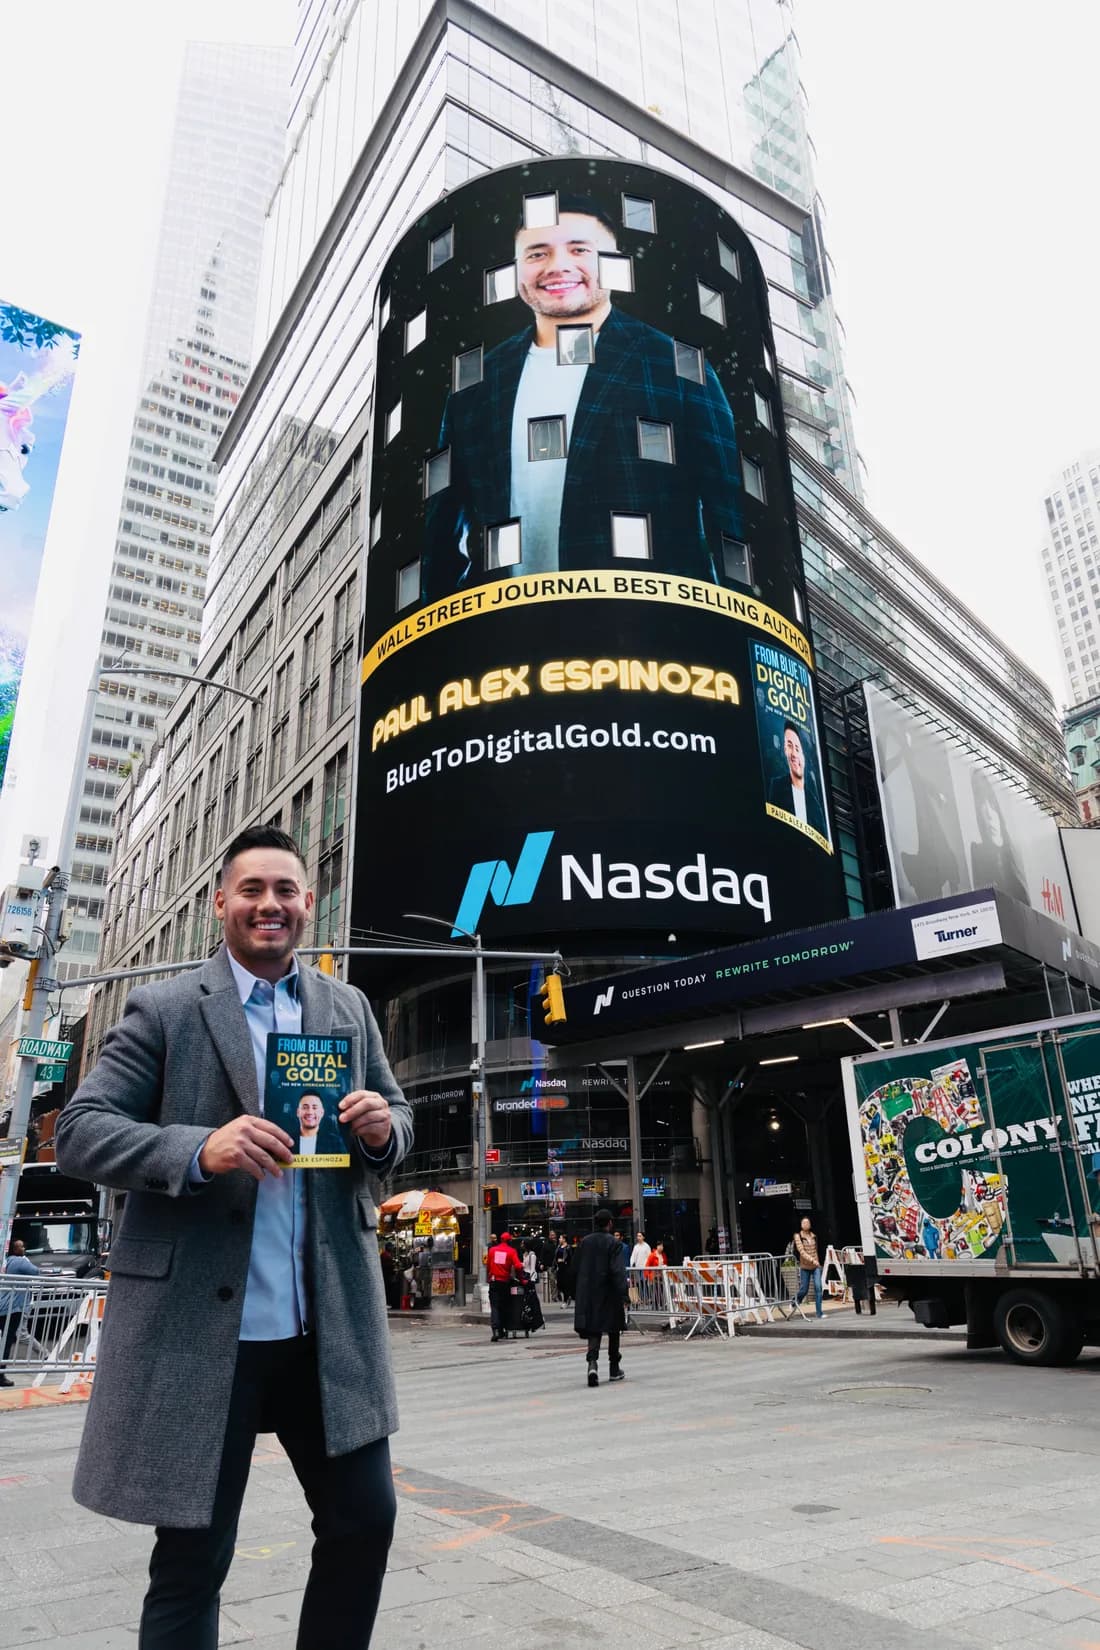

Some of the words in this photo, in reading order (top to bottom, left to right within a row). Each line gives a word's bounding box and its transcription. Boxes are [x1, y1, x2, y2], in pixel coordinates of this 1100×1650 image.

[376, 624, 413, 660] WALL
[416, 591, 487, 633] STREET
[491, 577, 606, 605] JOURNAL
[613, 577, 672, 597] BEST
[678, 583, 759, 622] SELLING
[763, 612, 810, 655] AUTHOR
[754, 644, 780, 669] FROM
[780, 653, 799, 681] BLUE
[756, 663, 811, 708] DIGITAL
[371, 694, 432, 753] PAUL
[439, 664, 531, 717] ALEX
[539, 659, 741, 705] ESPINOZA
[767, 687, 807, 722] GOLD
[386, 722, 717, 793] BlueToDigitalGold.com
[561, 853, 772, 923] Nasdaq
[934, 925, 978, 943] Turner
[622, 981, 670, 999] QUESTION
[674, 973, 707, 988] TODAY
[715, 959, 769, 979] REWRITE
[276, 1052, 348, 1068] DIGITAL
[278, 1038, 306, 1052] FROM
[308, 1039, 333, 1053] BLUE
[335, 1040, 348, 1054] TO
[40, 1065, 54, 1080] 43
[286, 1067, 337, 1082] GOLD
[535, 1079, 567, 1089] Nasdaq
[582, 1138, 627, 1150] Nasdaq
[914, 1115, 1063, 1164] COLONY
